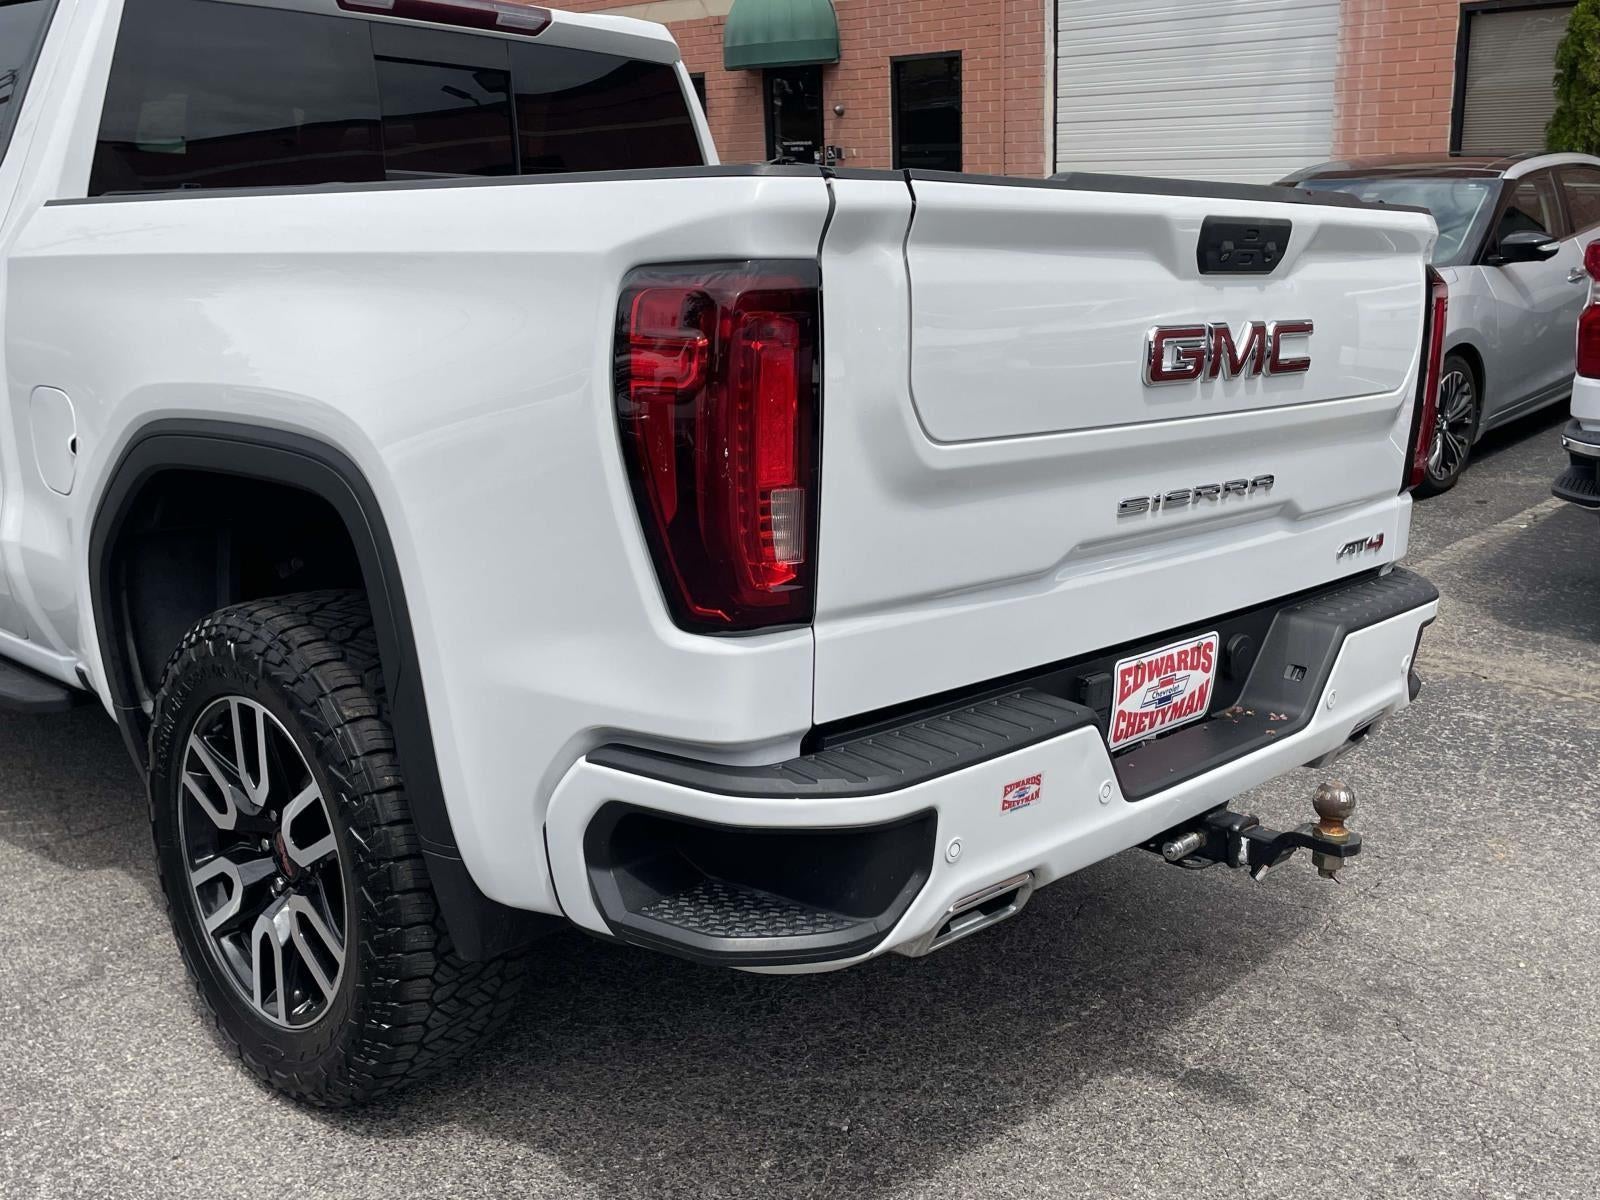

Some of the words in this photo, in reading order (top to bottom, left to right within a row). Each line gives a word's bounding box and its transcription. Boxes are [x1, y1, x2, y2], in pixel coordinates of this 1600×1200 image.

[1142, 319, 1313, 386] GMC
[1117, 474, 1275, 516] SIERRA
[1336, 532, 1384, 560] AT4
[1118, 642, 1213, 705] EDWARDS
[1113, 678, 1210, 743] CHEVYMAN
